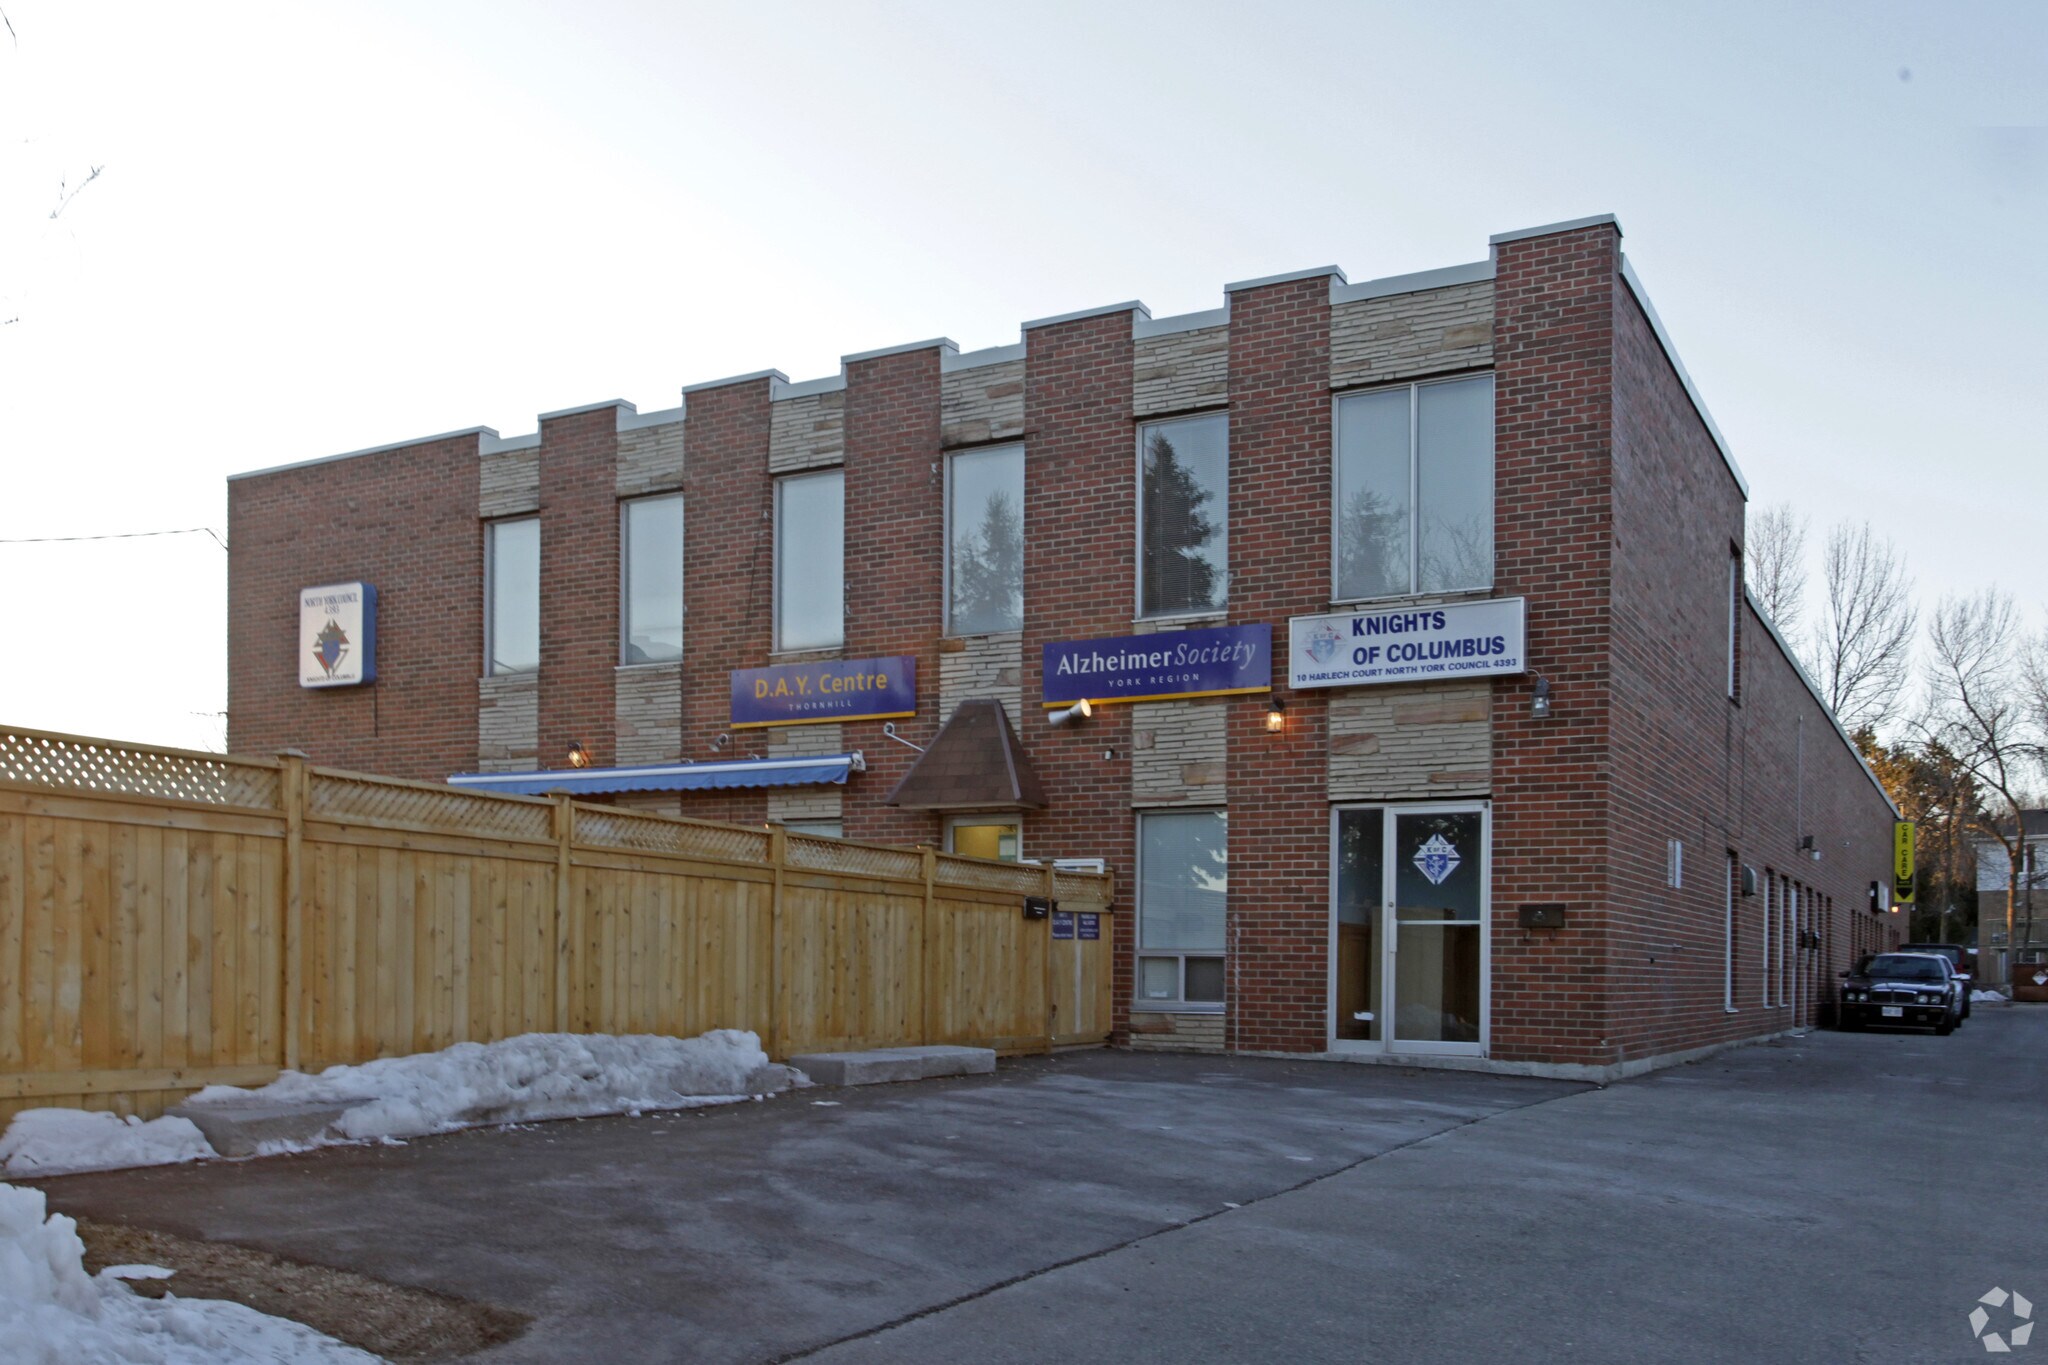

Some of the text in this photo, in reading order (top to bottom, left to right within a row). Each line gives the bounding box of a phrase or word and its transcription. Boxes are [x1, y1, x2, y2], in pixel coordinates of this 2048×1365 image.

[1352, 610, 1446, 636] KNIGHTS
[1056, 640, 1256, 676] Alzheimer Society
[1352, 635, 1505, 666] OF COLUMBUS
[1108, 673, 1200, 688] YORK REGION
[1296, 658, 1517, 682] 10 HARLECH COURT NORTH YORK COUNCIL 4393
[755, 672, 888, 699] D.A.Y. Centre
[789, 700, 852, 711] THORNHILL
